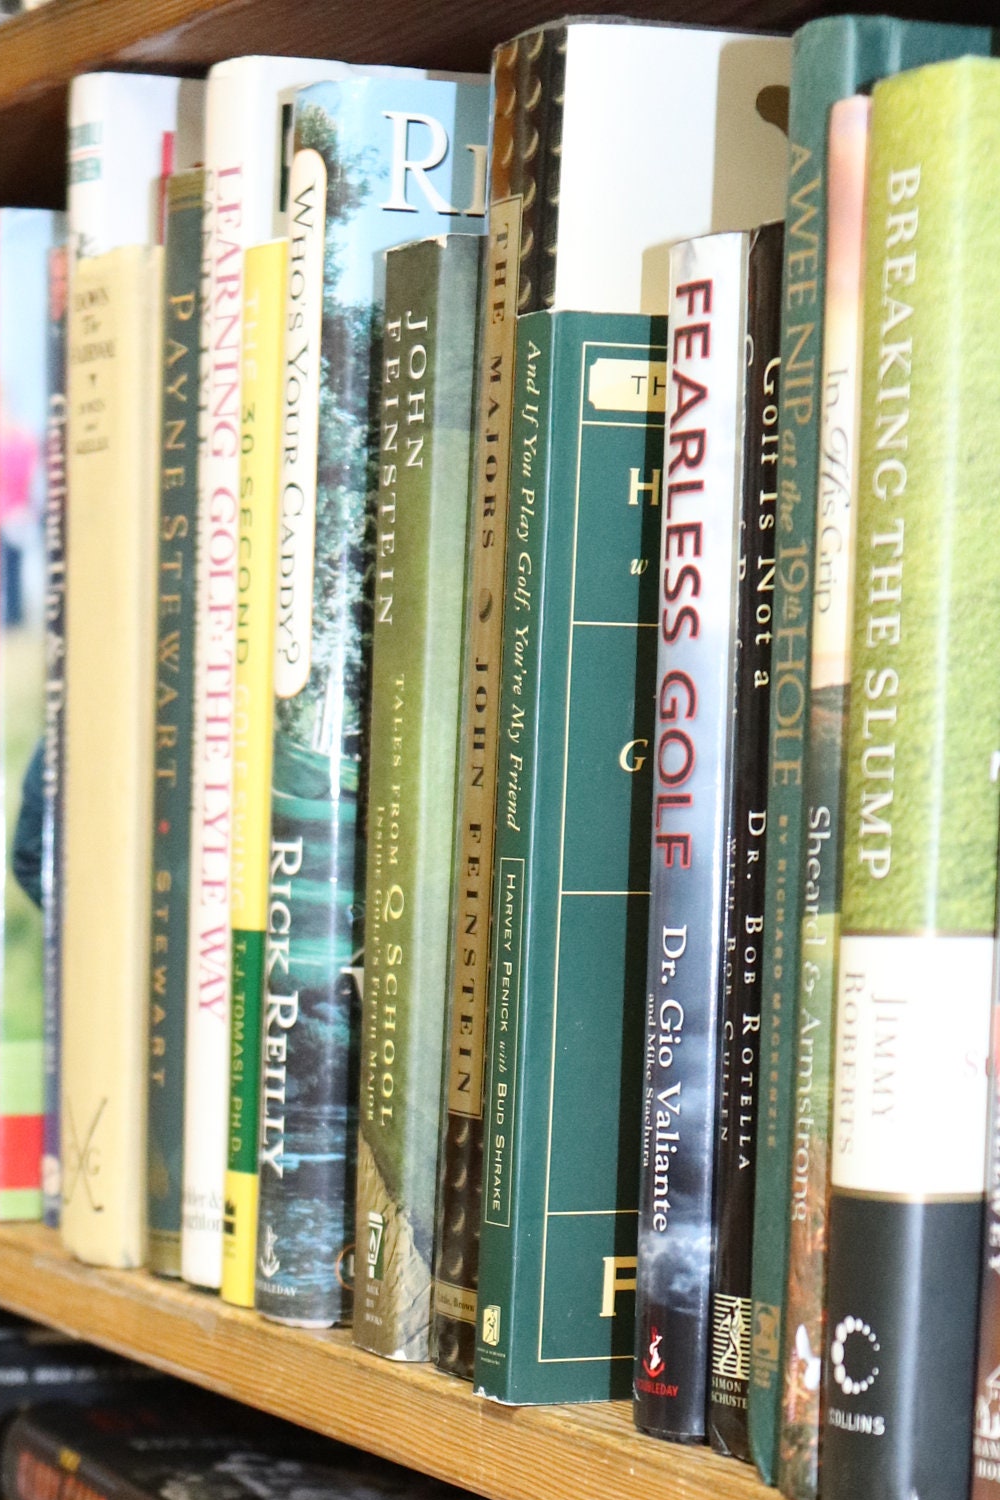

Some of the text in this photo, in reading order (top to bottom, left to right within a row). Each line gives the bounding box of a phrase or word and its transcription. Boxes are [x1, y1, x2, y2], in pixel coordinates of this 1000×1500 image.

[211, 167, 243, 459] LEARNING
[783, 178, 820, 314] WEE
[276, 183, 317, 665] WHO'S YOUR CADDY?
[404, 311, 428, 471] JOHN
[781, 322, 815, 426] NIP
[782, 430, 797, 469] at
[156, 292, 197, 788] PAYNE STEWART
[377, 317, 402, 626] FEINSTEIN
[759, 487, 776, 531] Is
[778, 473, 800, 534] the
[857, 166, 921, 880] BREAKING THE SLUMP
[505, 340, 542, 833] And If You Play Golf, You're My Friend
[655, 279, 714, 869] FEARLESS GOLF
[755, 554, 776, 648] Not
[779, 540, 810, 624] 19th
[816, 514, 846, 615] Grip
[204, 651, 235, 764] THE
[456, 223, 509, 1098] THE MAJORS JOHN FEINSTEIN
[772, 626, 806, 786] HOLE
[202, 782, 231, 906] LYLE
[379, 673, 406, 1128] TALES FROM Q SCHOOL
[803, 806, 833, 946] Sheard
[152, 869, 172, 1089] STEWART
[198, 925, 227, 1023] WAY
[259, 836, 303, 1180] RICK REILLY
[490, 873, 517, 1211] HARVEY PENICK with BUD SHRAKE
[737, 811, 767, 1171] DR. BOB ROTELLA
[838, 969, 867, 1155] ROBERTS
[871, 993, 909, 1118] JIMMY
[642, 993, 657, 1168] and Mike Stachura
[650, 923, 688, 1234] Dr. Gio Valiante
[791, 1013, 823, 1222] Armstrong
